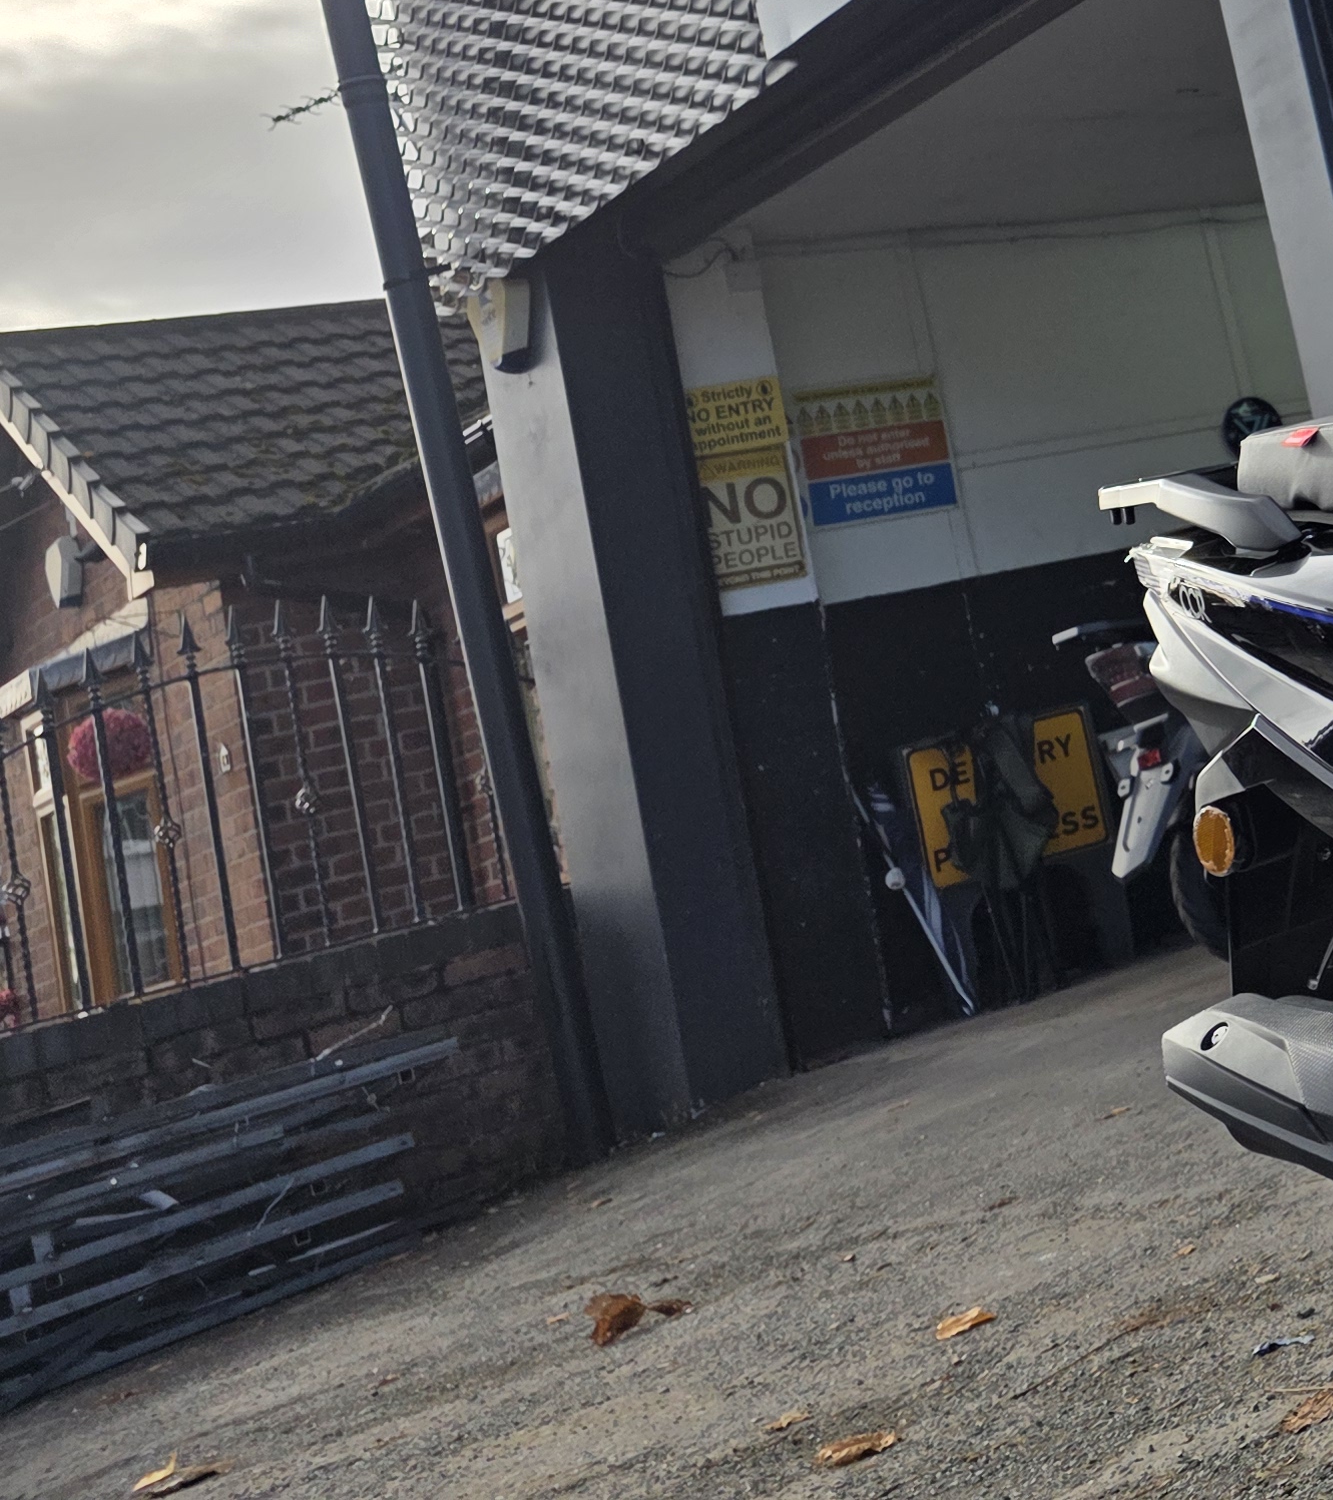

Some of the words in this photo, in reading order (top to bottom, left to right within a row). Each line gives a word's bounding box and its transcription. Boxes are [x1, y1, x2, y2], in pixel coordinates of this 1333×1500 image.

[701, 385, 752, 403] Strictly
[715, 397, 774, 421] ENTRY
[695, 418, 750, 436] without
[754, 415, 773, 428] an
[838, 435, 855, 447] Do
[714, 455, 780, 473] WARNING
[829, 479, 888, 499] Please
[892, 476, 913, 495] go
[917, 471, 935, 485] to
[700, 476, 788, 527] NO
[845, 491, 926, 515] reception
[708, 521, 793, 551] STUPID
